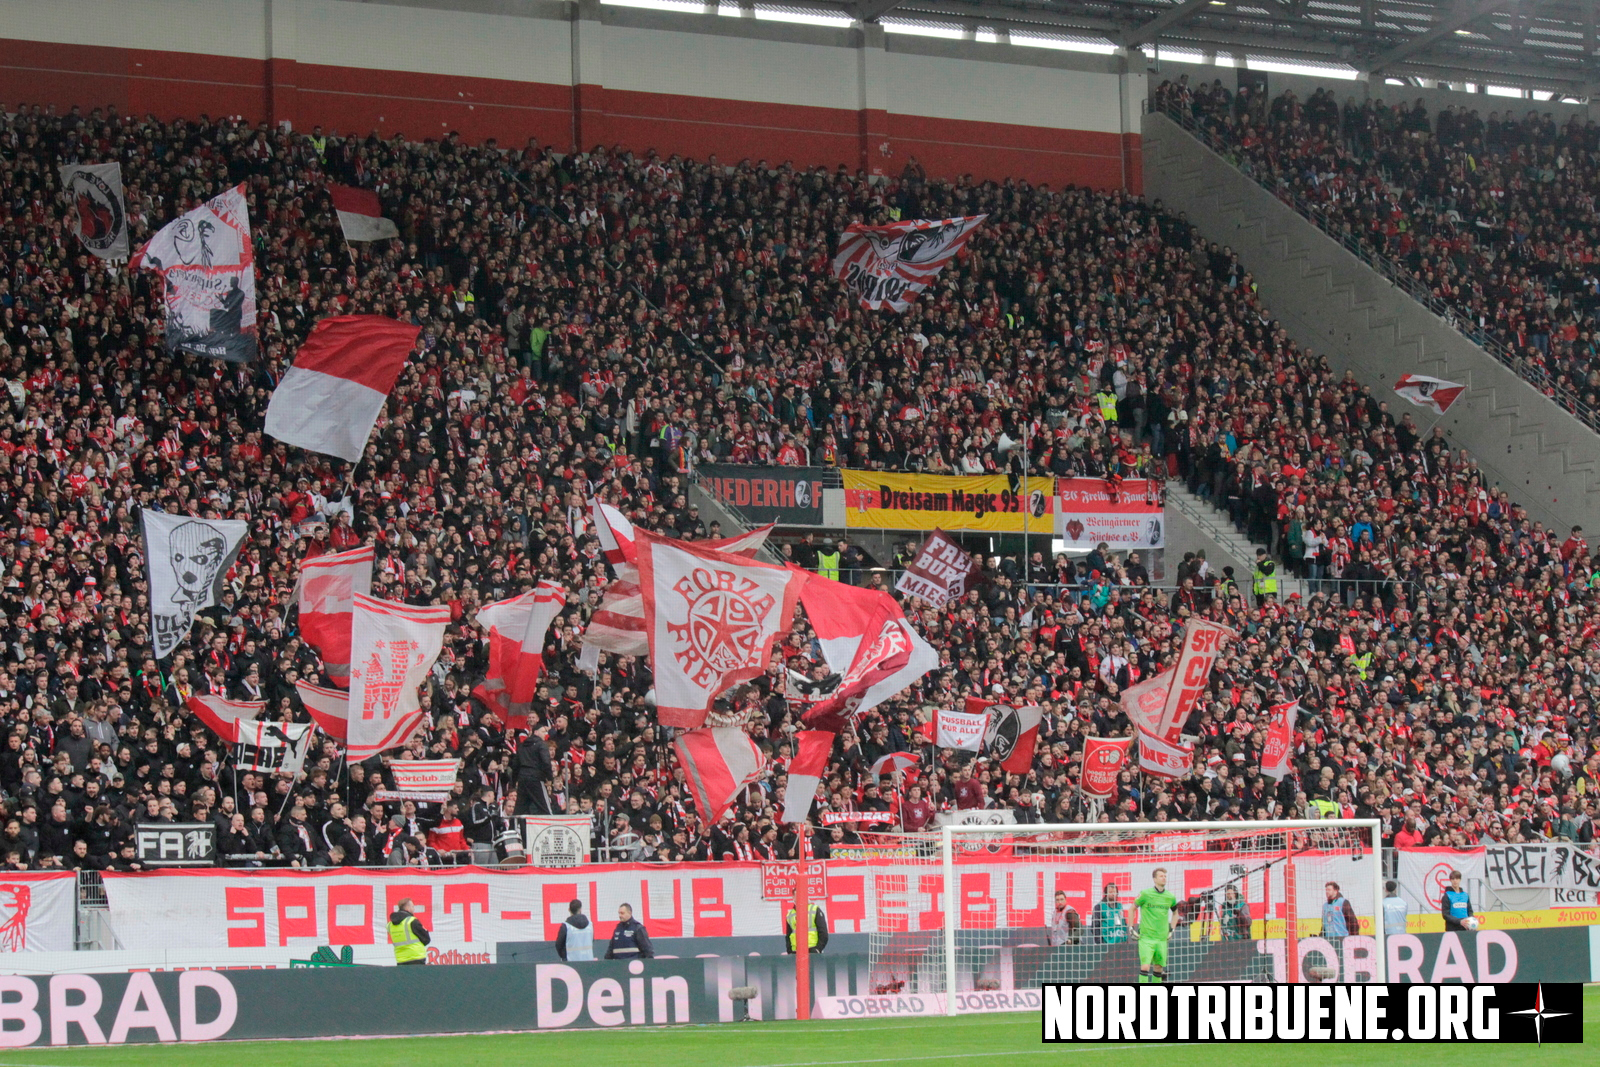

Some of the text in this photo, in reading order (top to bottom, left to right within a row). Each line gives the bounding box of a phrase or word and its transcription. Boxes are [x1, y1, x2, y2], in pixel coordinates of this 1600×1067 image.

[880, 484, 1019, 518] Dreisam Magic 95
[1081, 490, 1121, 504] Freibug
[1086, 517, 1140, 529] Weingärtner
[941, 716, 982, 727] FUSSBALL
[942, 724, 980, 735] FÜR ALLE
[765, 877, 787, 887] FÜR
[1569, 911, 1598, 922] LOTTO
[427, 947, 491, 965] Rothaus
[536, 960, 690, 1028] Dein
[838, 997, 925, 1016] JOBRAD
[956, 992, 1042, 1011] JOBRAD
